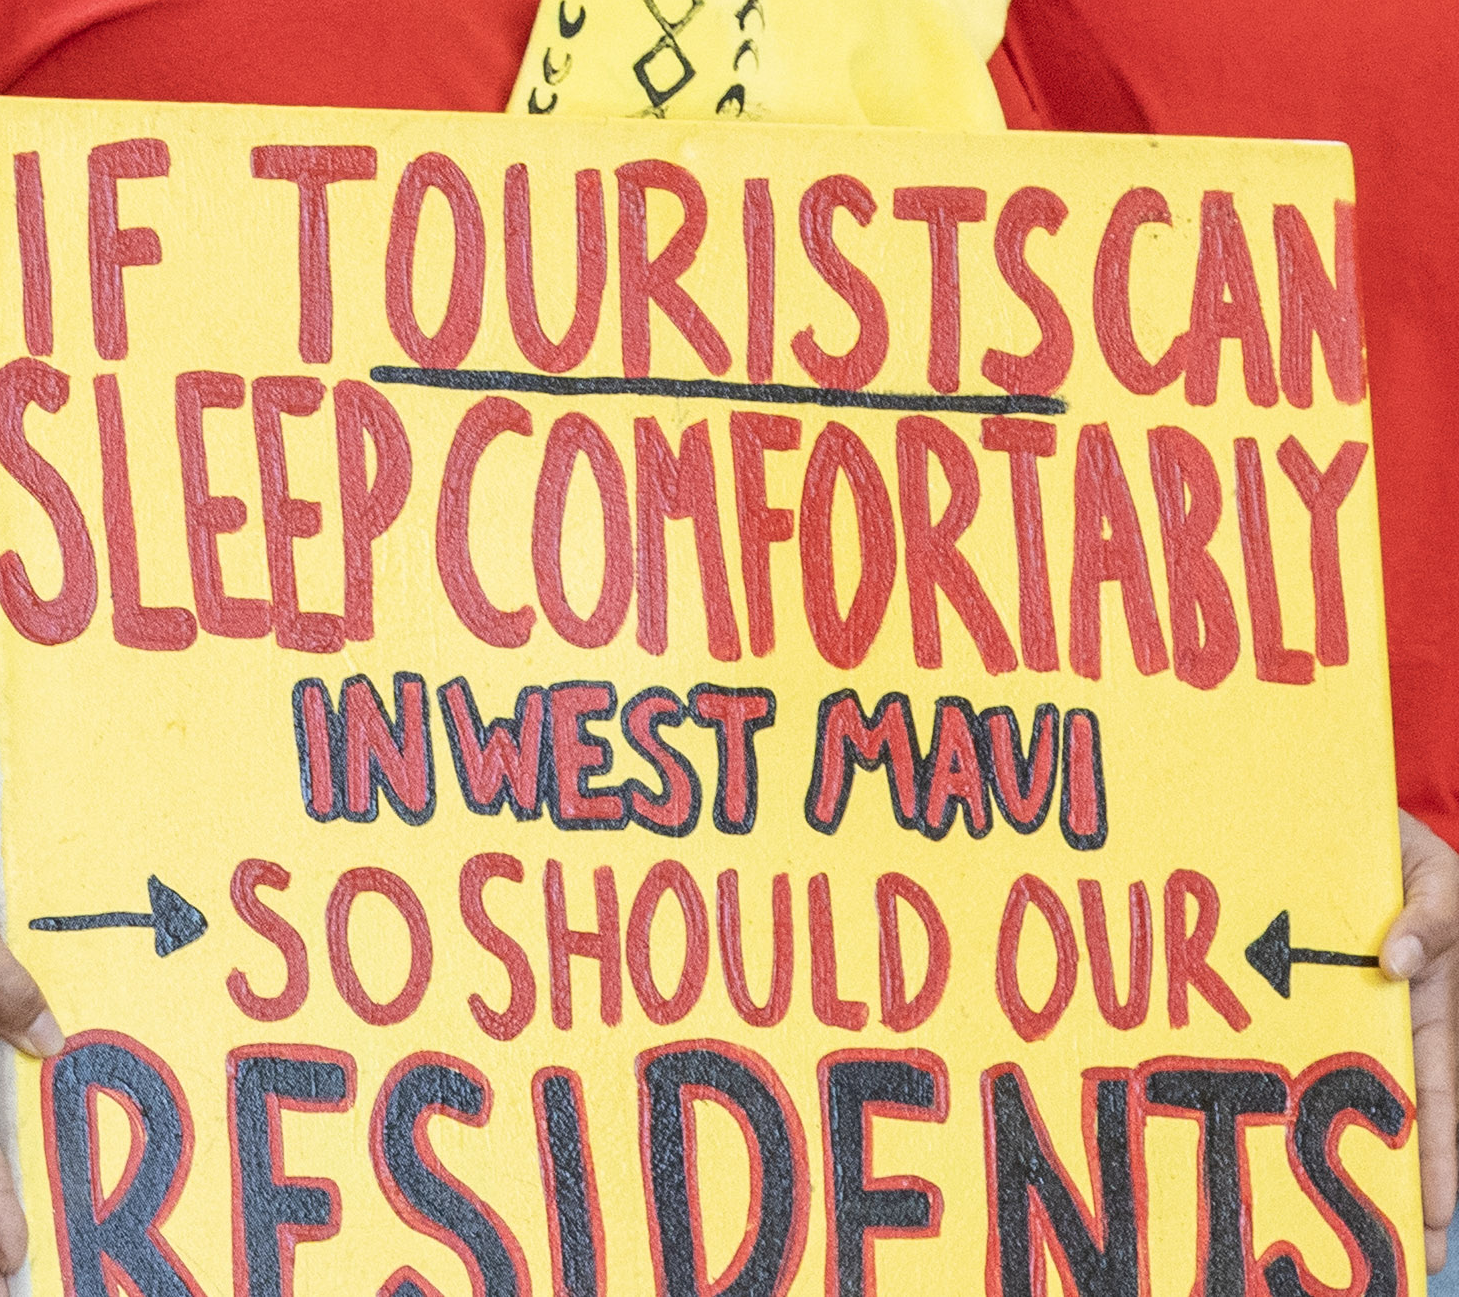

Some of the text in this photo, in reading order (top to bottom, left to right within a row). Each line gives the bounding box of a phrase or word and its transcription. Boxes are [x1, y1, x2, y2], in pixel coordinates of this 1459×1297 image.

[12, 138, 1367, 409] IF TOURISTS CAN
[435, 395, 1369, 690] COMFORTABLY
[293, 673, 1110, 851] IN WEST MAUI
[226, 852, 1251, 1042] SO SHOULD OUR
[38, 1029, 1417, 1297] RESIDENTS
